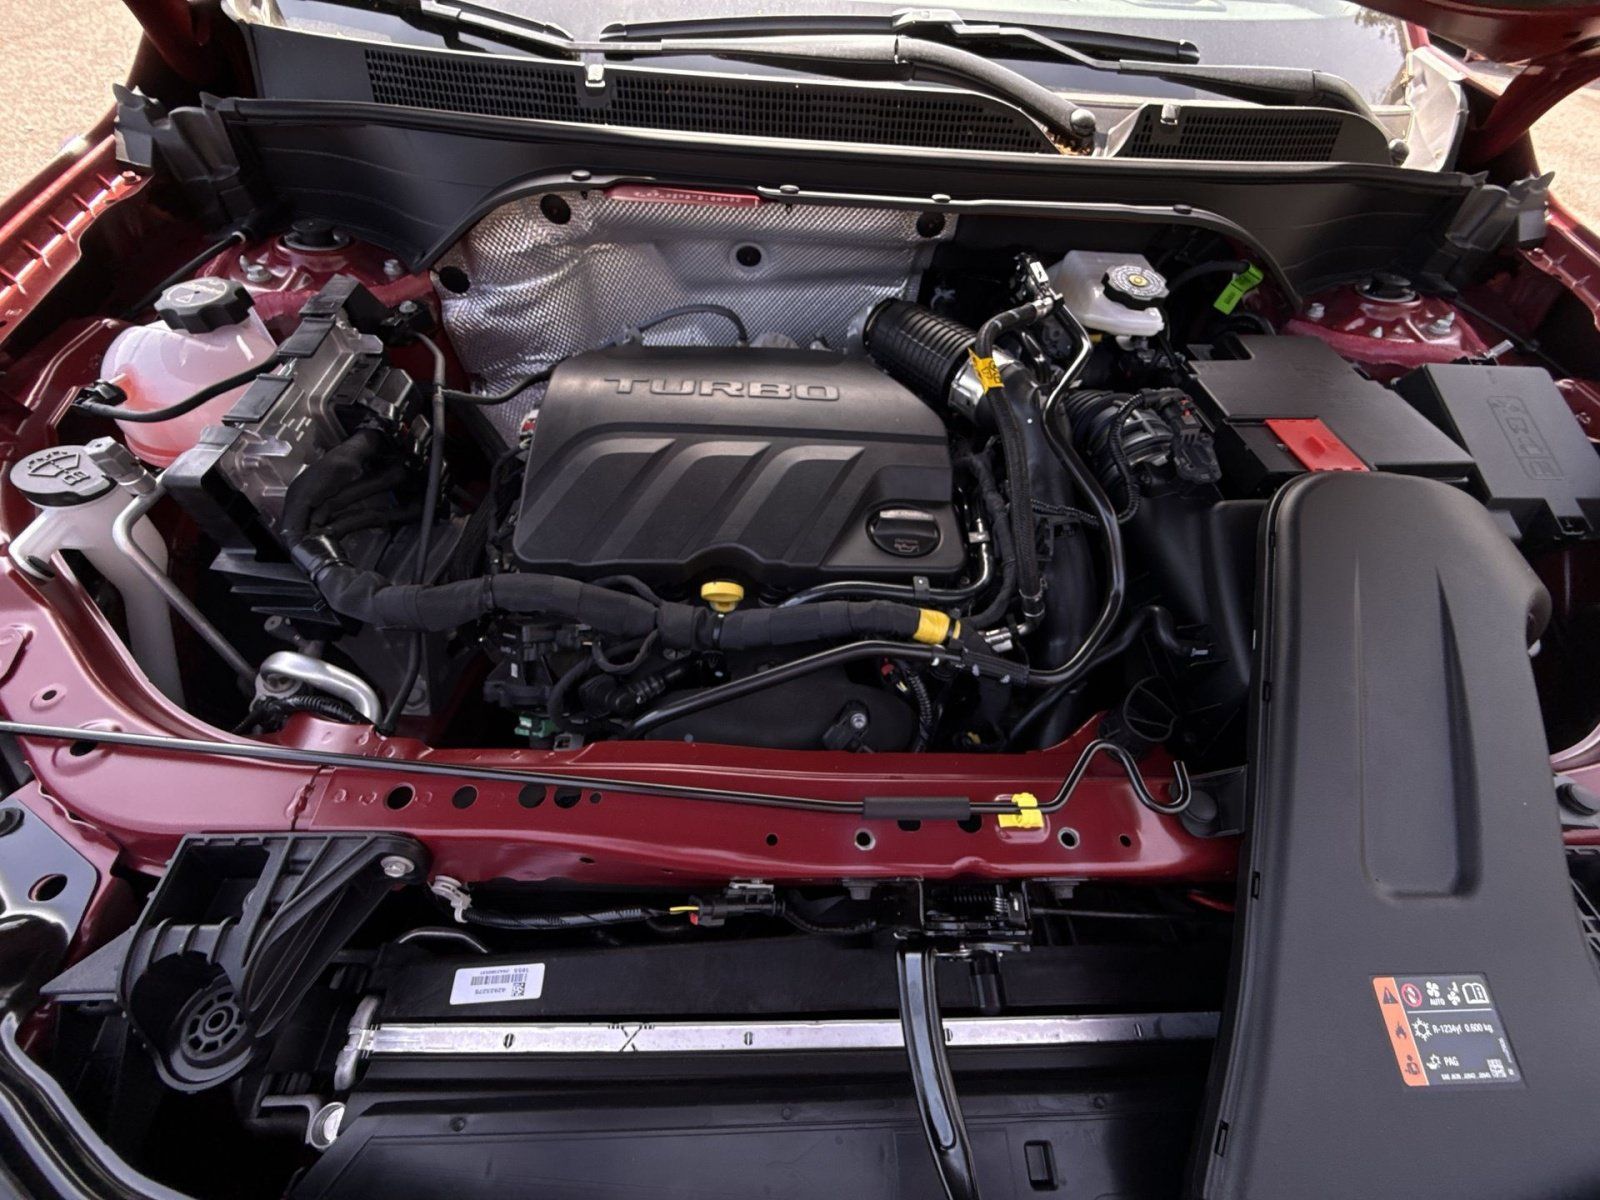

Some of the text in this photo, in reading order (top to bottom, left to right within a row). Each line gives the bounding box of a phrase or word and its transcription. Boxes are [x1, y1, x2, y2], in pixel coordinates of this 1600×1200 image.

[604, 377, 840, 402] TURBO
[1429, 998, 1446, 1006] AUTO
[1483, 1023, 1494, 1033] kg
[1443, 1057, 1460, 1067] PAG
